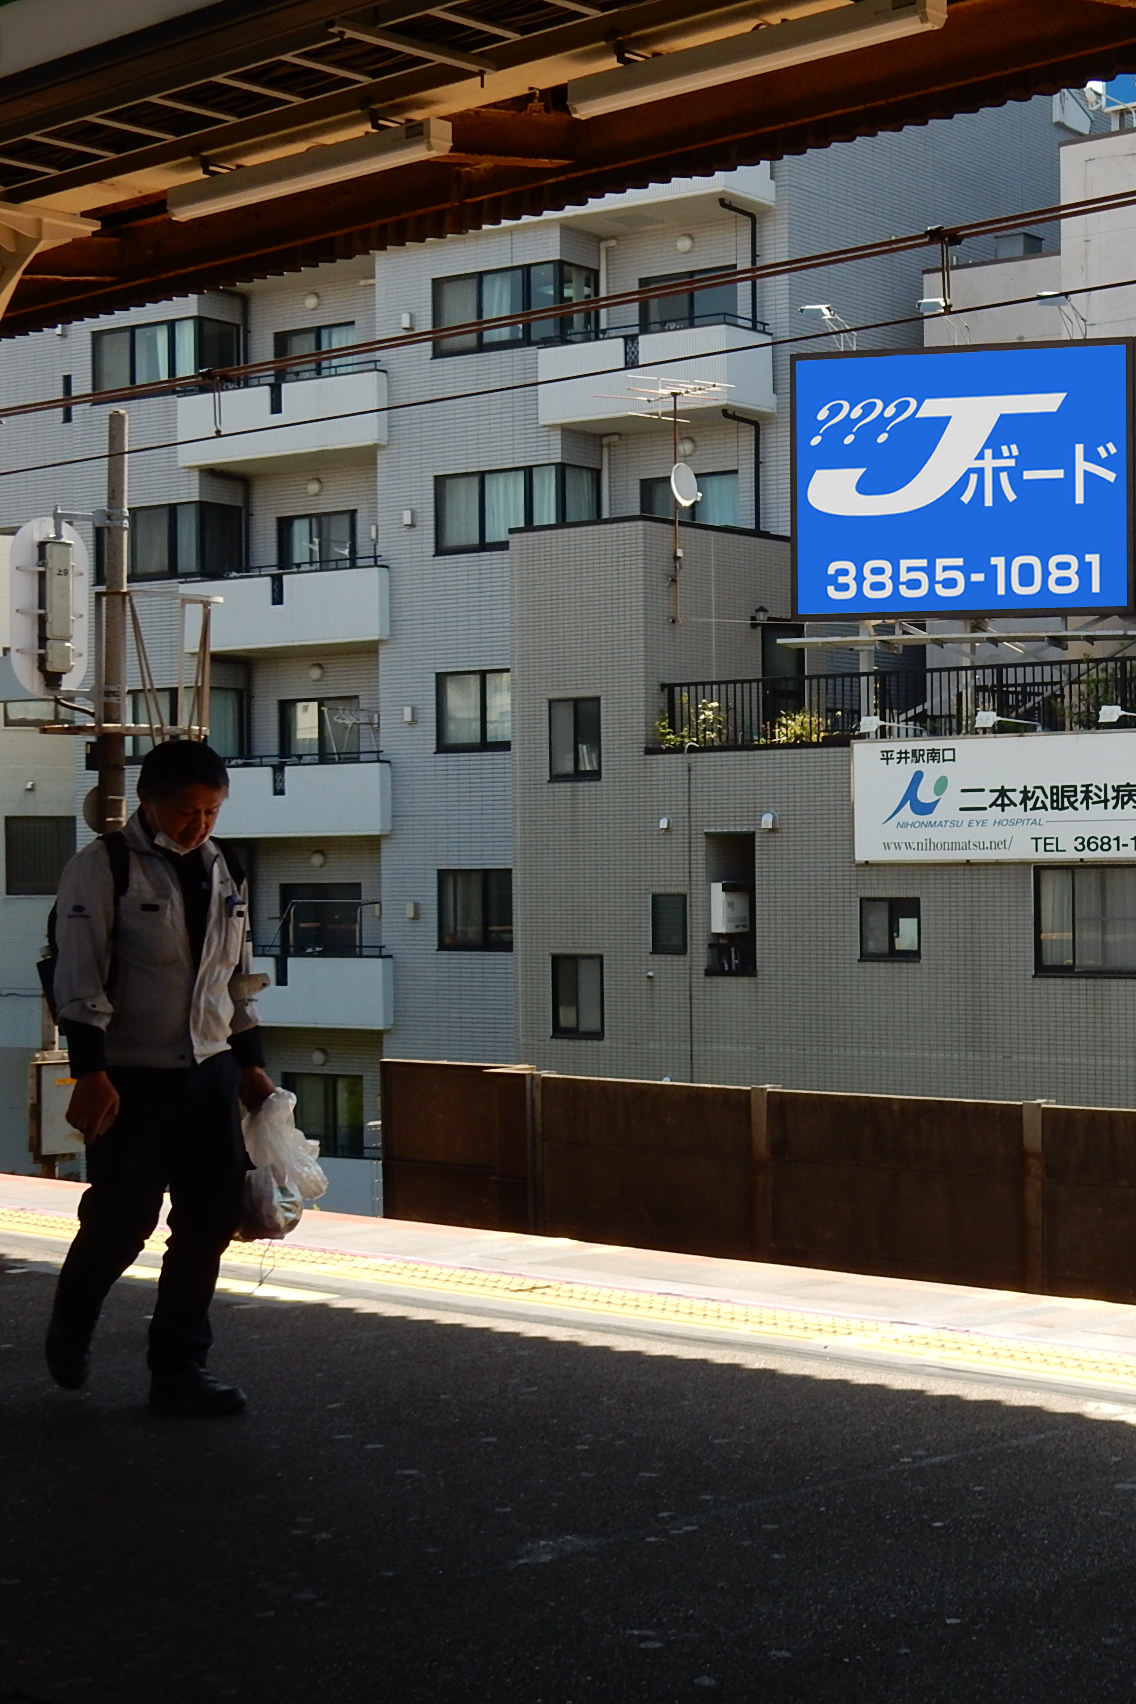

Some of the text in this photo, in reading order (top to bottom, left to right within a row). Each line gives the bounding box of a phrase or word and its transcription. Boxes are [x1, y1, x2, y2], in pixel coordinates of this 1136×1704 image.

[826, 553, 1101, 601] 3855-1081
[880, 747, 956, 765] 平井駅南口
[896, 817, 1044, 829] NIHONMATSU EYE HOSPITAL
[882, 835, 1014, 851] www.nihonmatsu.net/
[1030, 836, 1066, 853] TEL
